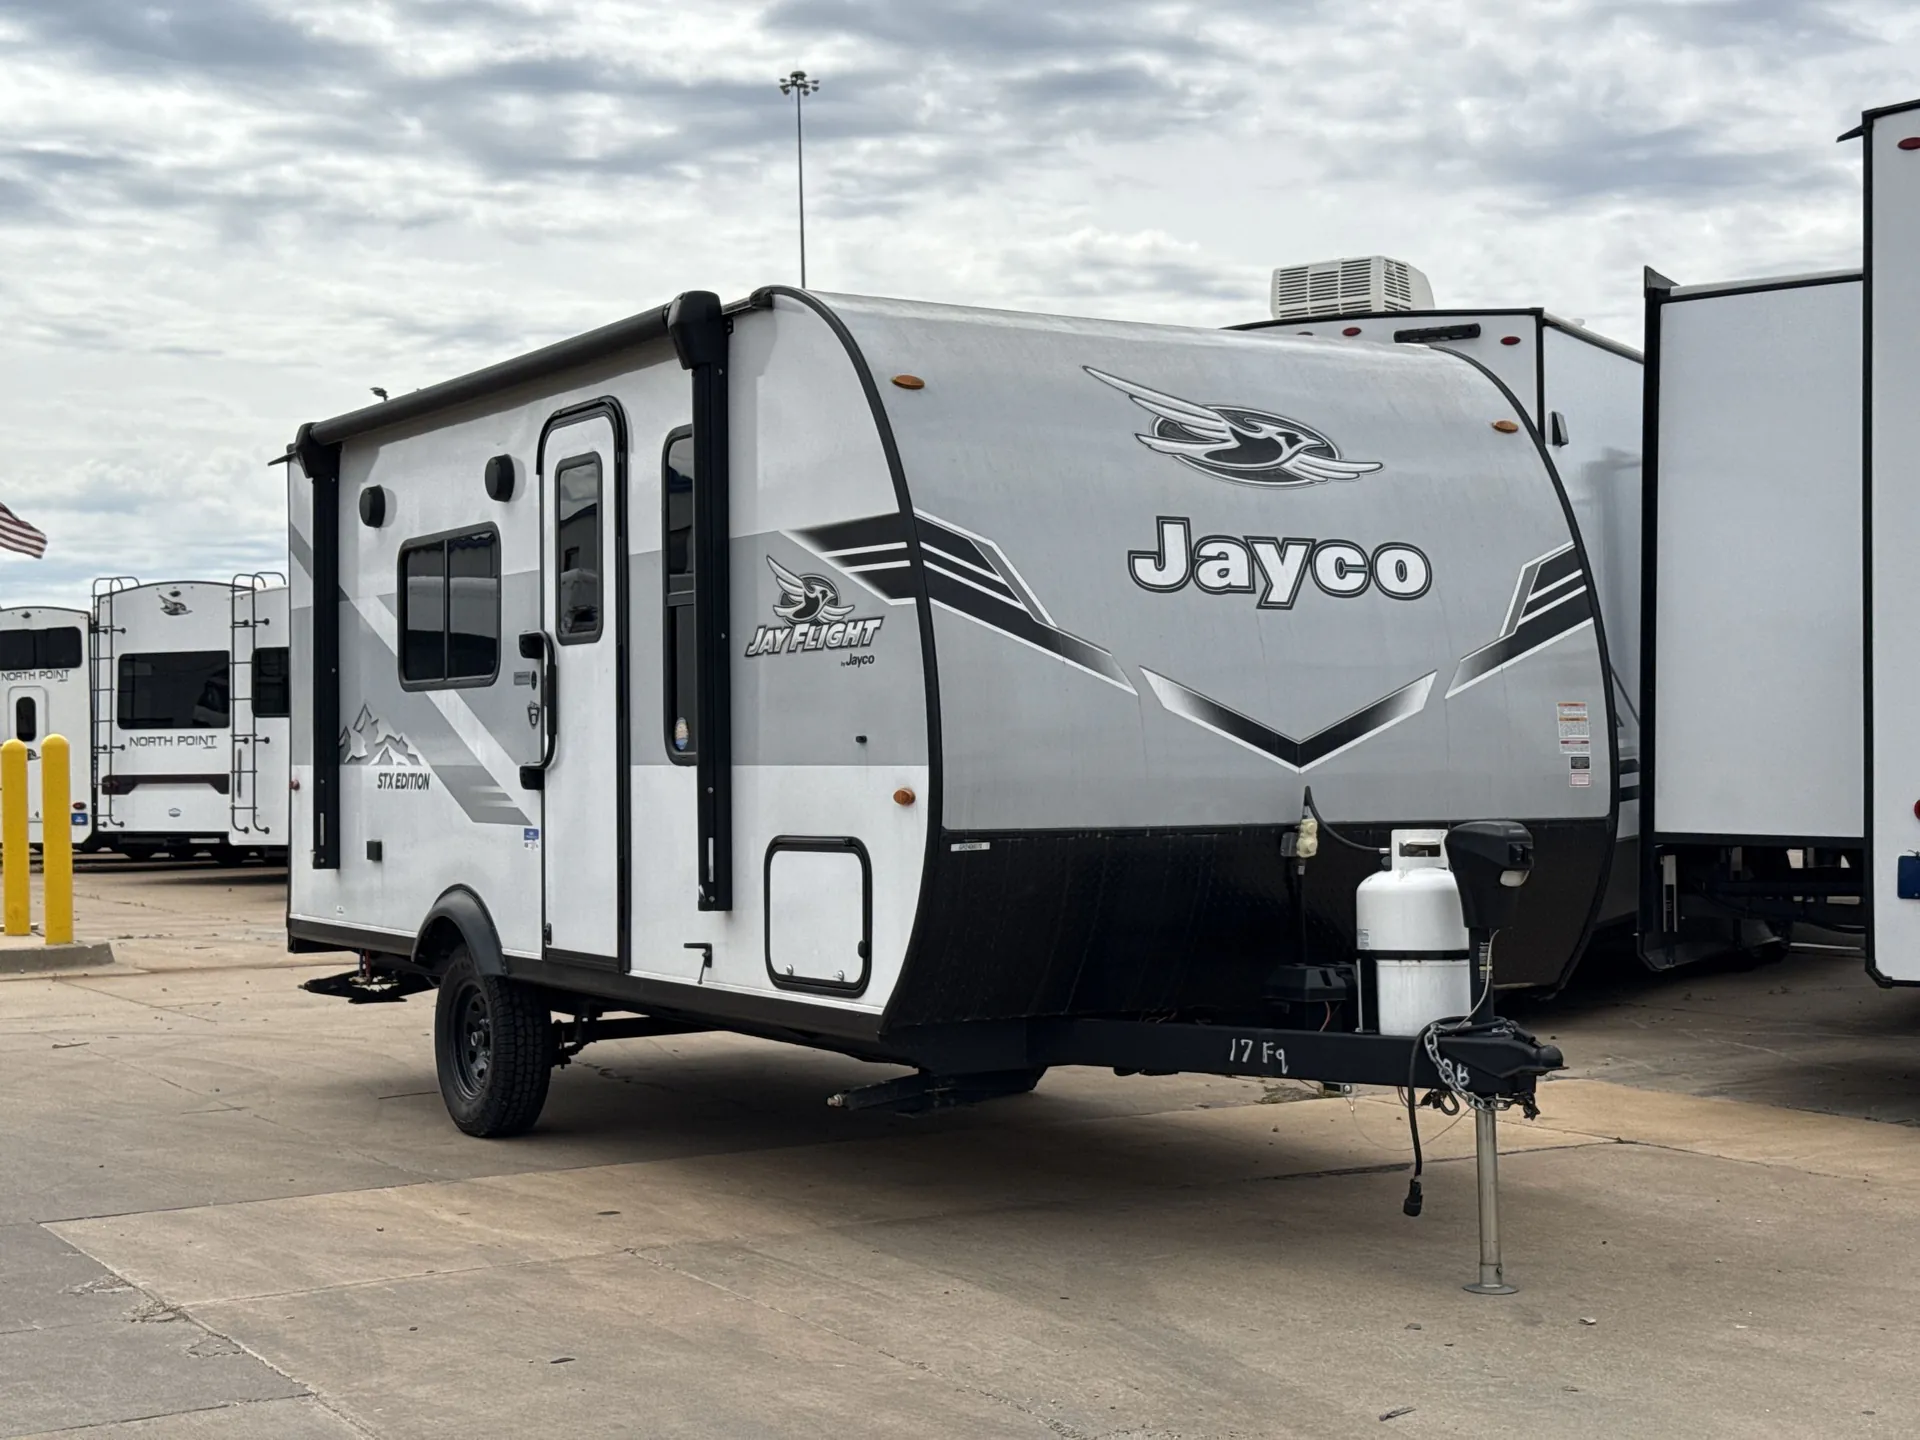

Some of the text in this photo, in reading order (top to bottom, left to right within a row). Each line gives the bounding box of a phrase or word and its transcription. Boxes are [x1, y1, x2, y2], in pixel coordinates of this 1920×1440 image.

[1128, 516, 1432, 610] Jayco
[744, 616, 885, 657] JAY FLIGHT
[846, 653, 875, 667] Jayco
[1, 670, 70, 681] NORTH POINT
[129, 735, 217, 746] NORTH POINT
[377, 772, 431, 790] STX EDITION
[1229, 1038, 1253, 1063] 17
